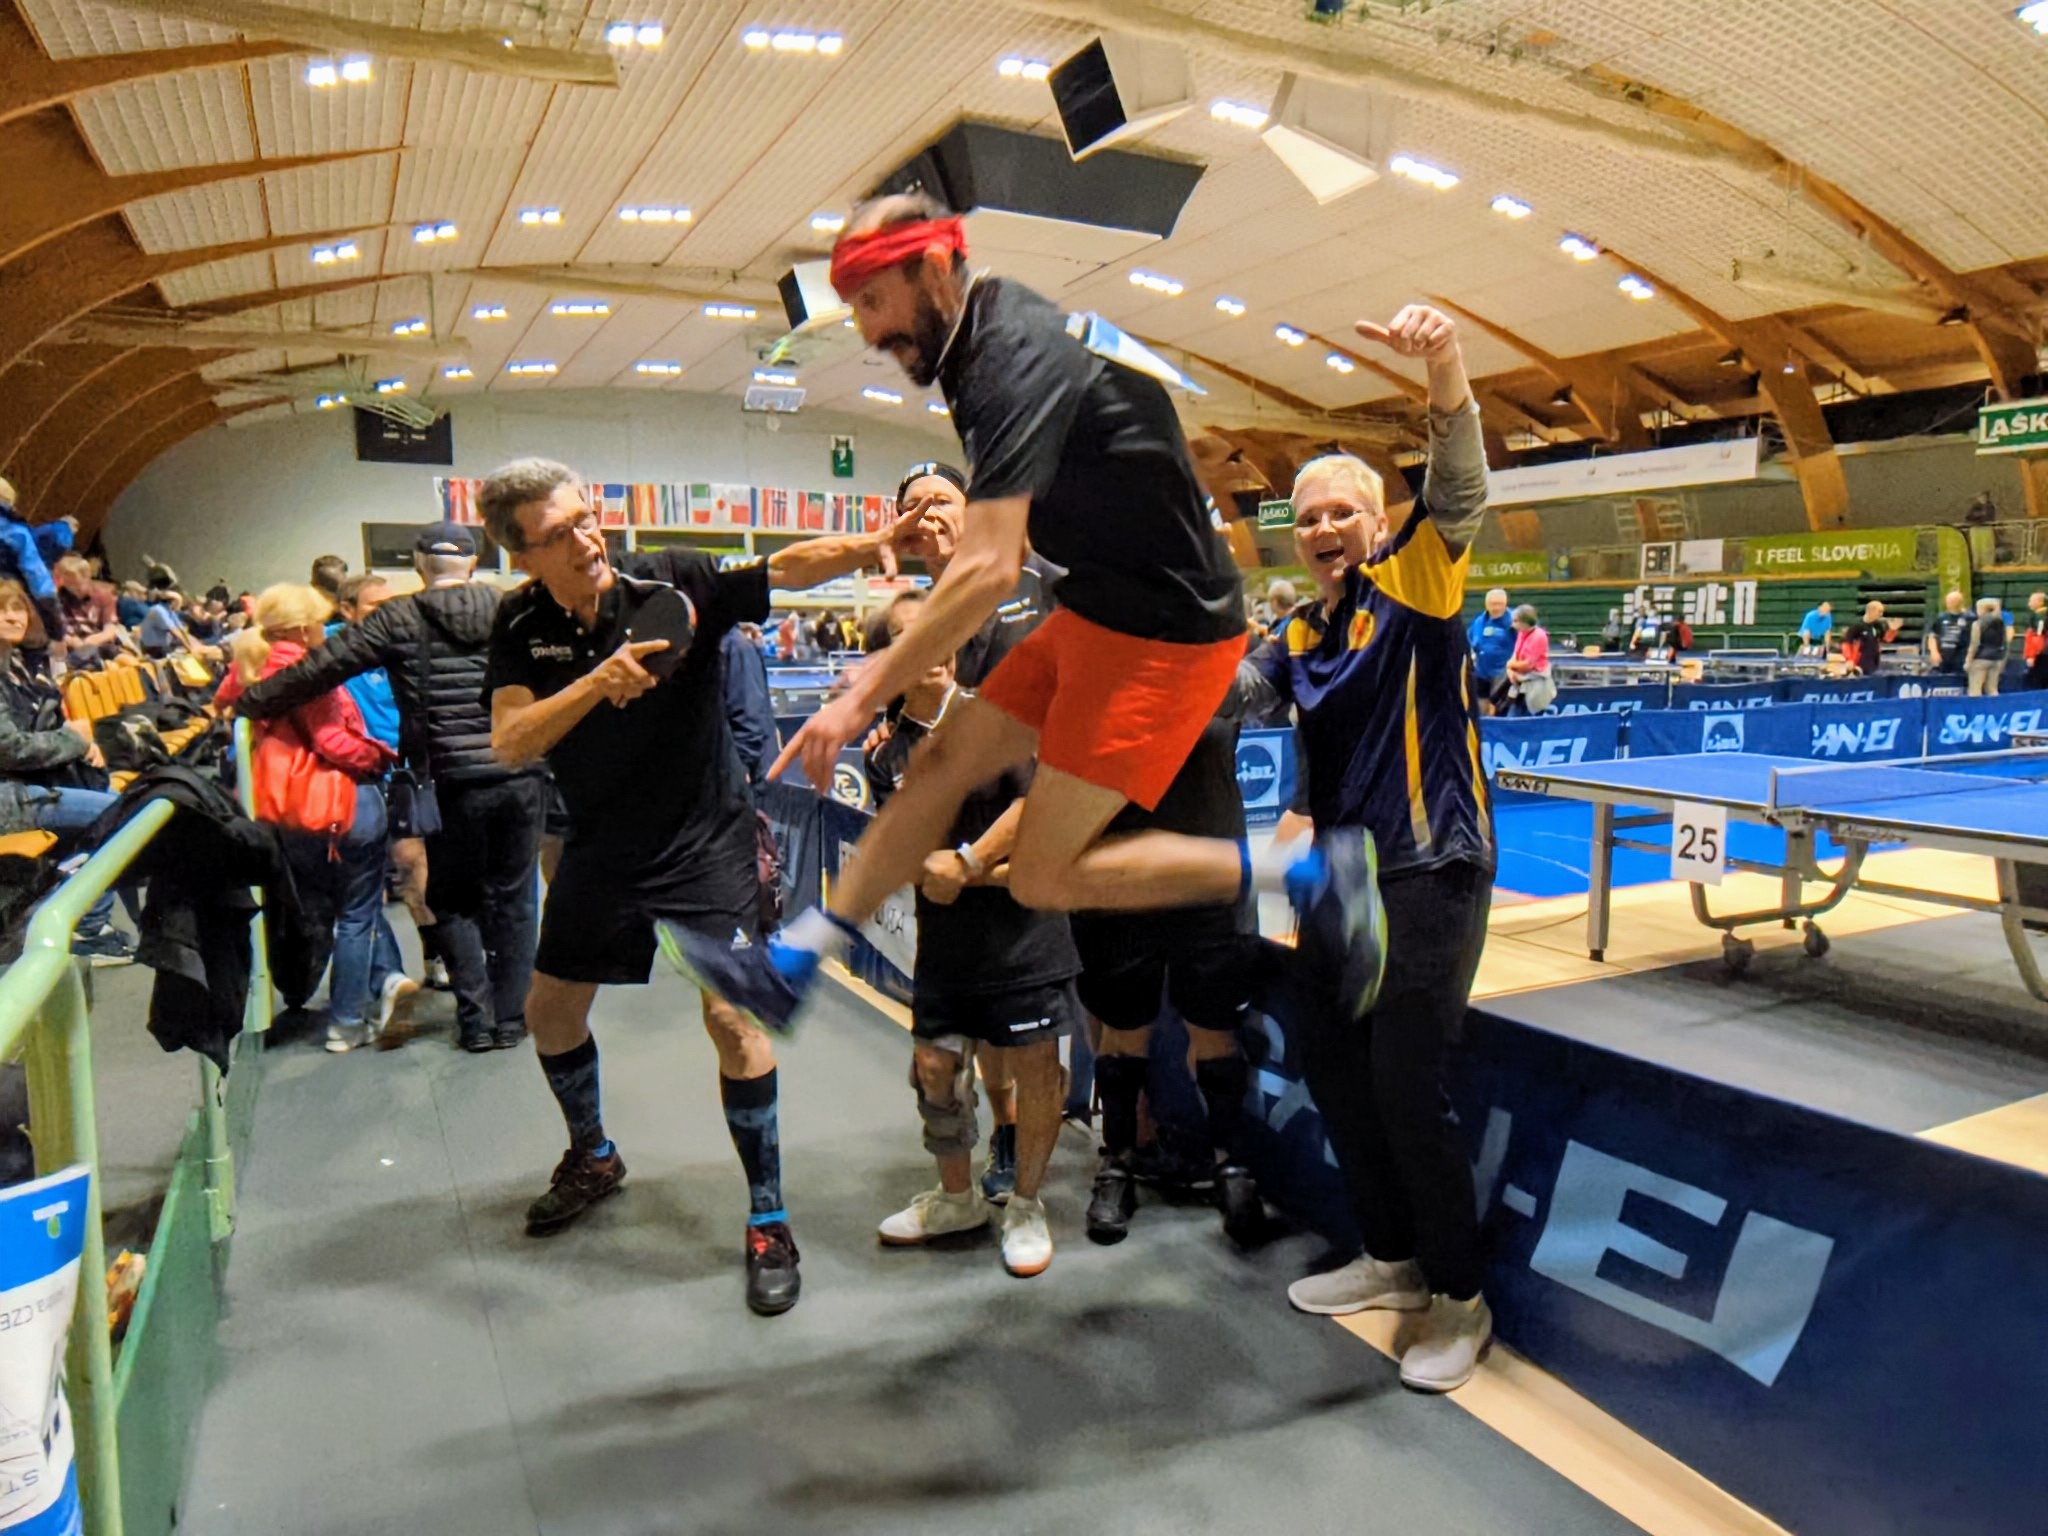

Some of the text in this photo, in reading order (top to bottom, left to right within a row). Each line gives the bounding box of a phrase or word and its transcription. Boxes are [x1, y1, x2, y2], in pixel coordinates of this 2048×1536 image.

[1755, 543, 1901, 565] I FEEL SLOVENIA
[1678, 824, 1718, 864] 25
